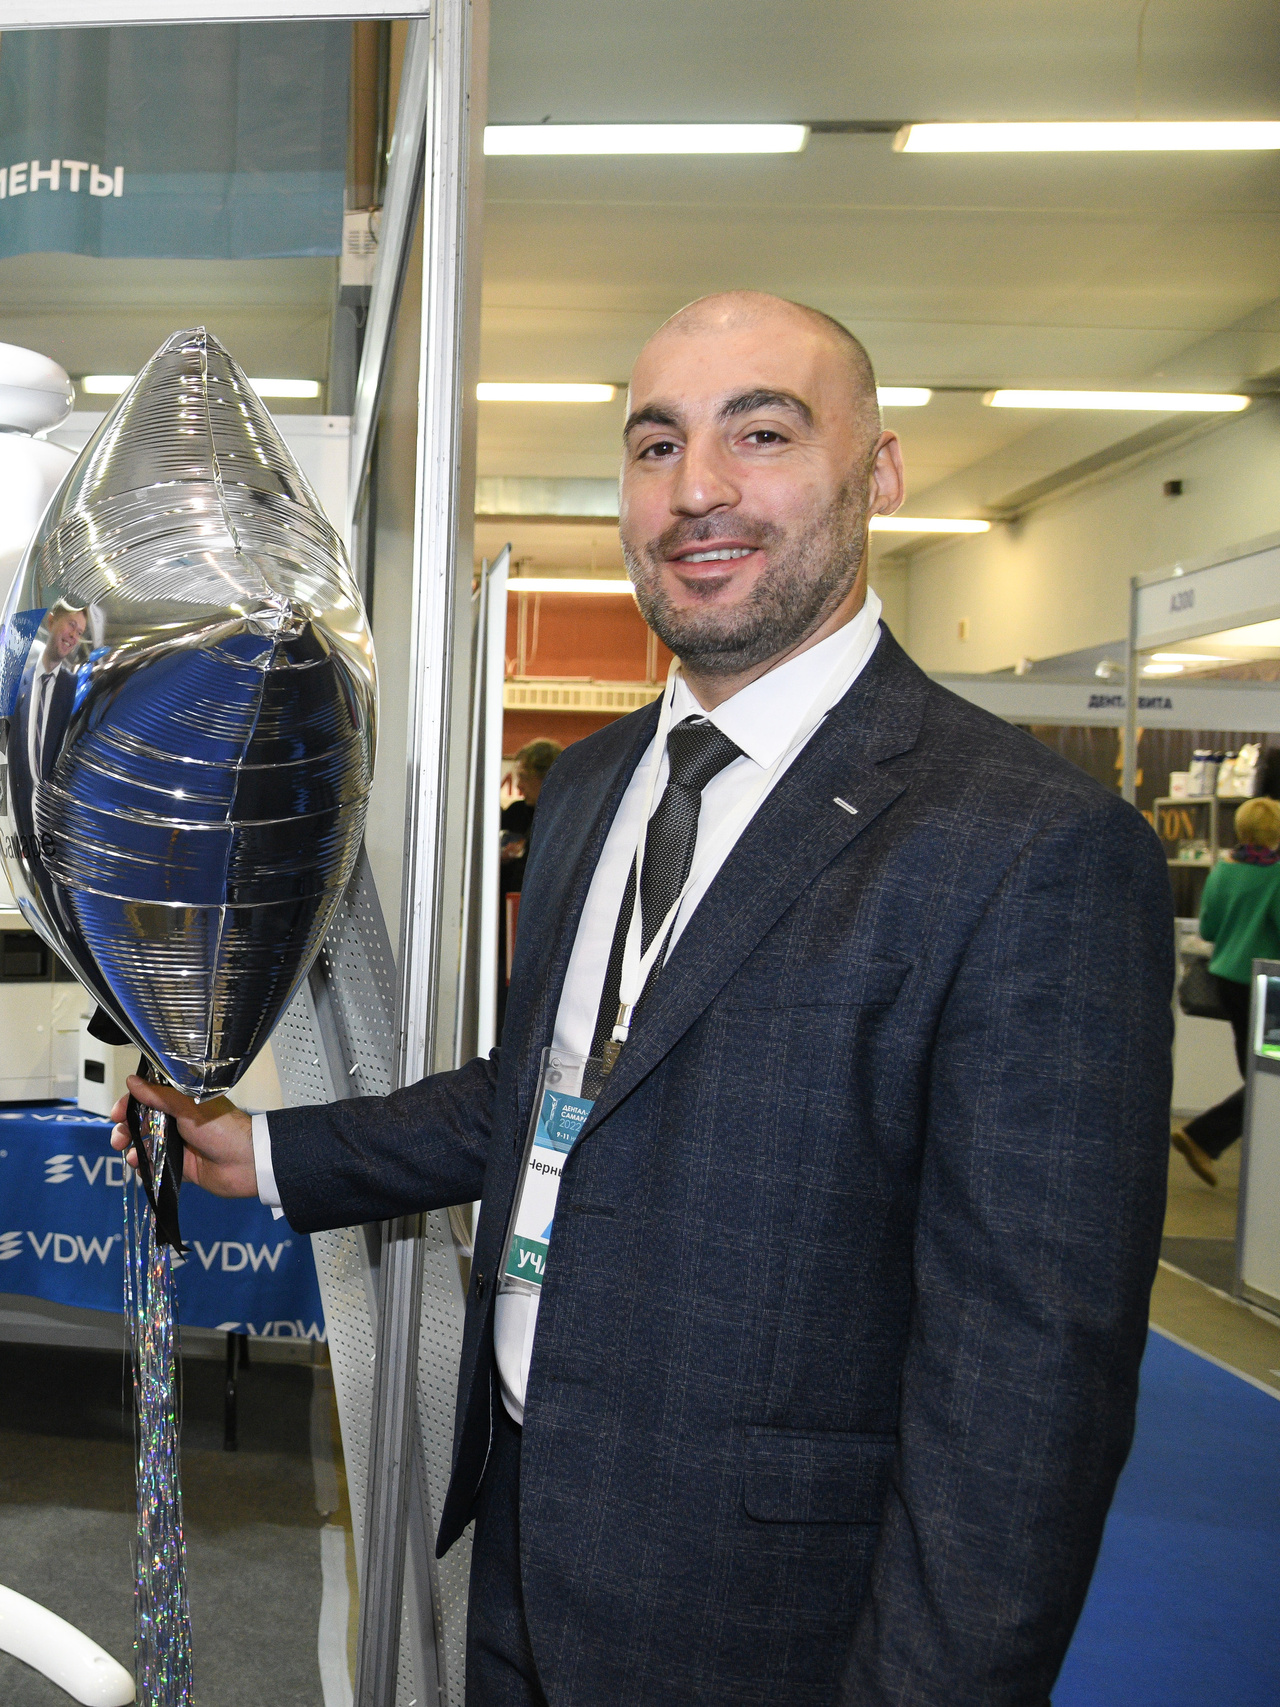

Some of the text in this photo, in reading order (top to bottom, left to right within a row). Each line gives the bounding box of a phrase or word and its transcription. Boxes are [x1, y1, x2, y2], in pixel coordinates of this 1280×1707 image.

[556, 1131, 570, 1141] 9-11
[558, 1117, 583, 1132] 2022
[26, 1231, 114, 1265] VDW
[193, 1241, 284, 1272] VDW
